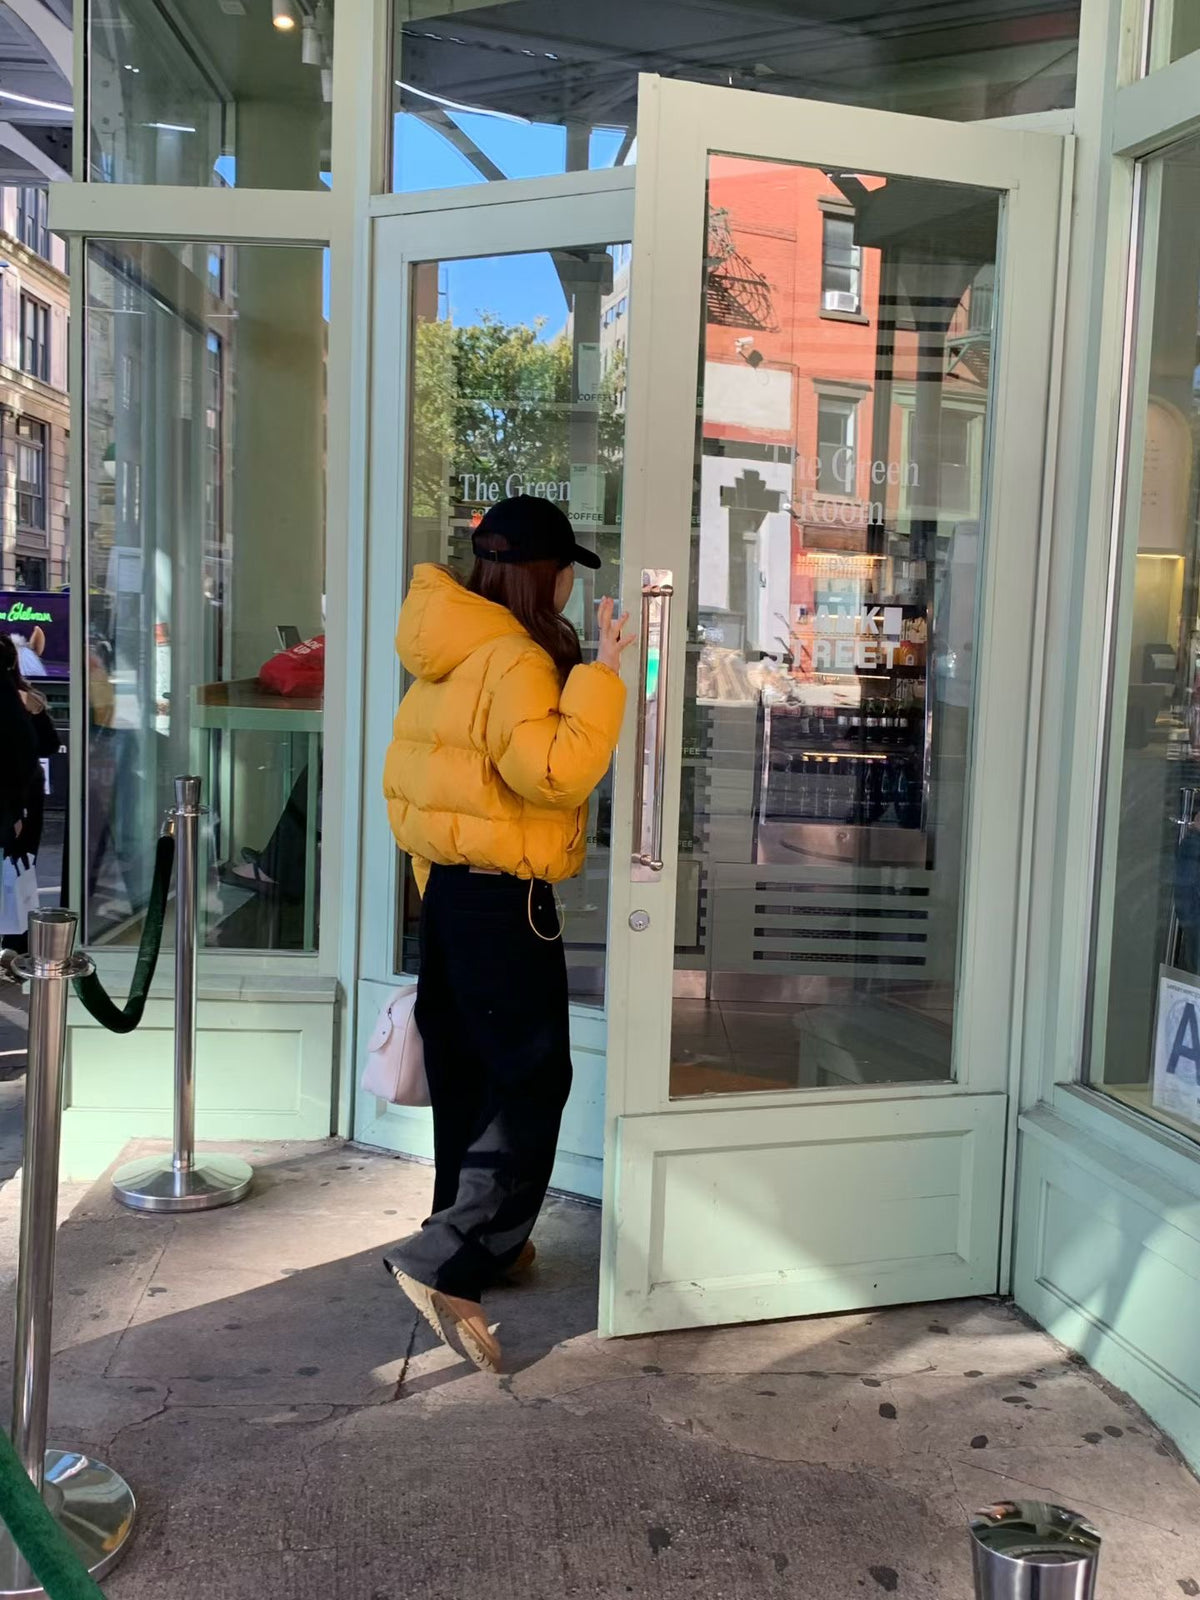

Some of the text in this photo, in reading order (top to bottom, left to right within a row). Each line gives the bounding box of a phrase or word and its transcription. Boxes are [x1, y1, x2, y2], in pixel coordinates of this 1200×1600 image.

[832, 447, 920, 487] Green
[459, 473, 571, 502] The Green
[800, 487, 884, 526] Room
[567, 512, 604, 521] COFFEE
[1166, 1003, 1200, 1086] A
